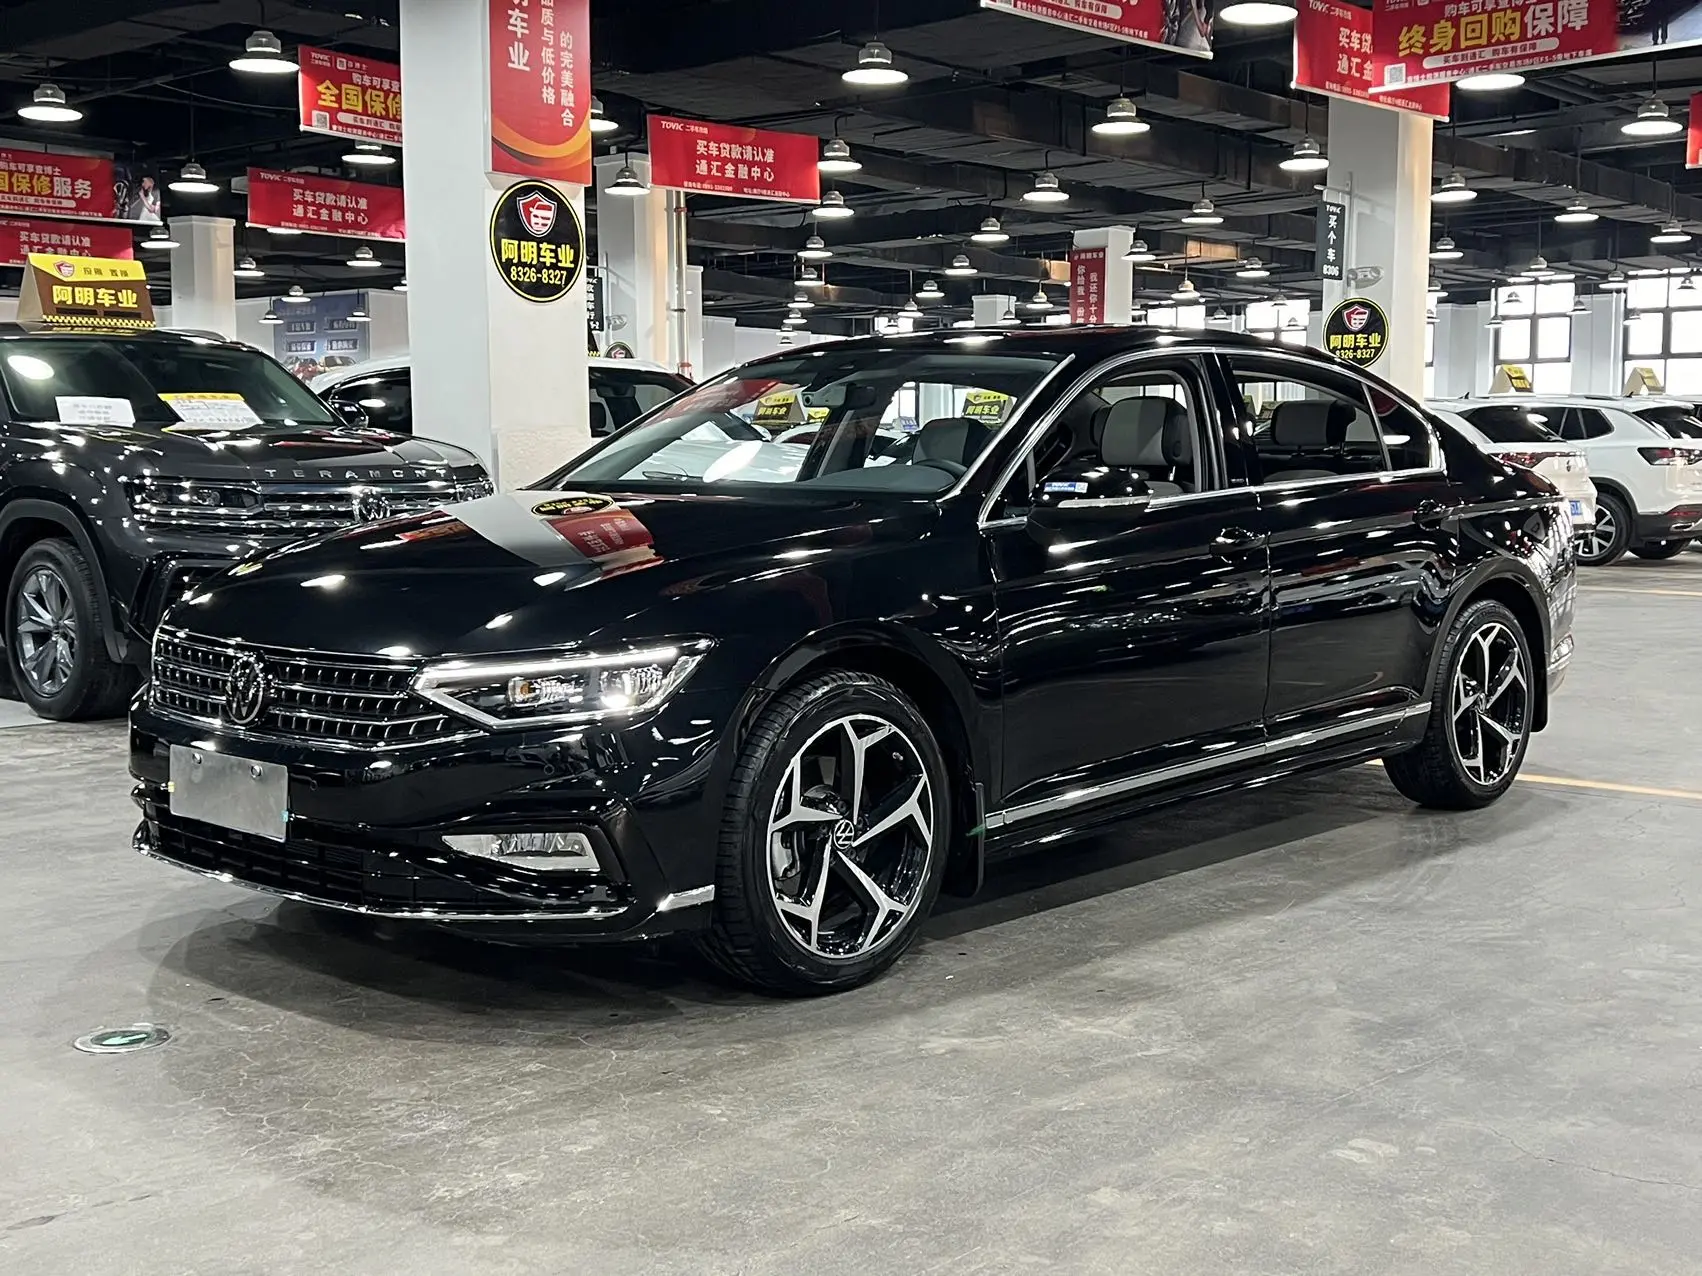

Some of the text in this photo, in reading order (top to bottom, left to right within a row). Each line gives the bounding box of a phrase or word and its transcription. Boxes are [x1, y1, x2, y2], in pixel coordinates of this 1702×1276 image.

[1339, 27, 1373, 53] 买车贷
[1398, 0, 1589, 57] 终身回购保障
[560, 31, 575, 127] 的完美融合
[661, 121, 684, 131] TOVIC
[697, 139, 775, 163] 买车贷款请认准
[695, 159, 775, 182] 通汇金融中心
[293, 188, 368, 209] 买车贷款请认准
[292, 204, 369, 225] 通汇金融中心
[1327, 215, 1337, 262] 买个车
[501, 238, 574, 268] 阿明车业
[510, 265, 567, 285] 8326-8327
[52, 285, 138, 308] 阿明车业
[1329, 332, 1381, 350] 阿明车业
